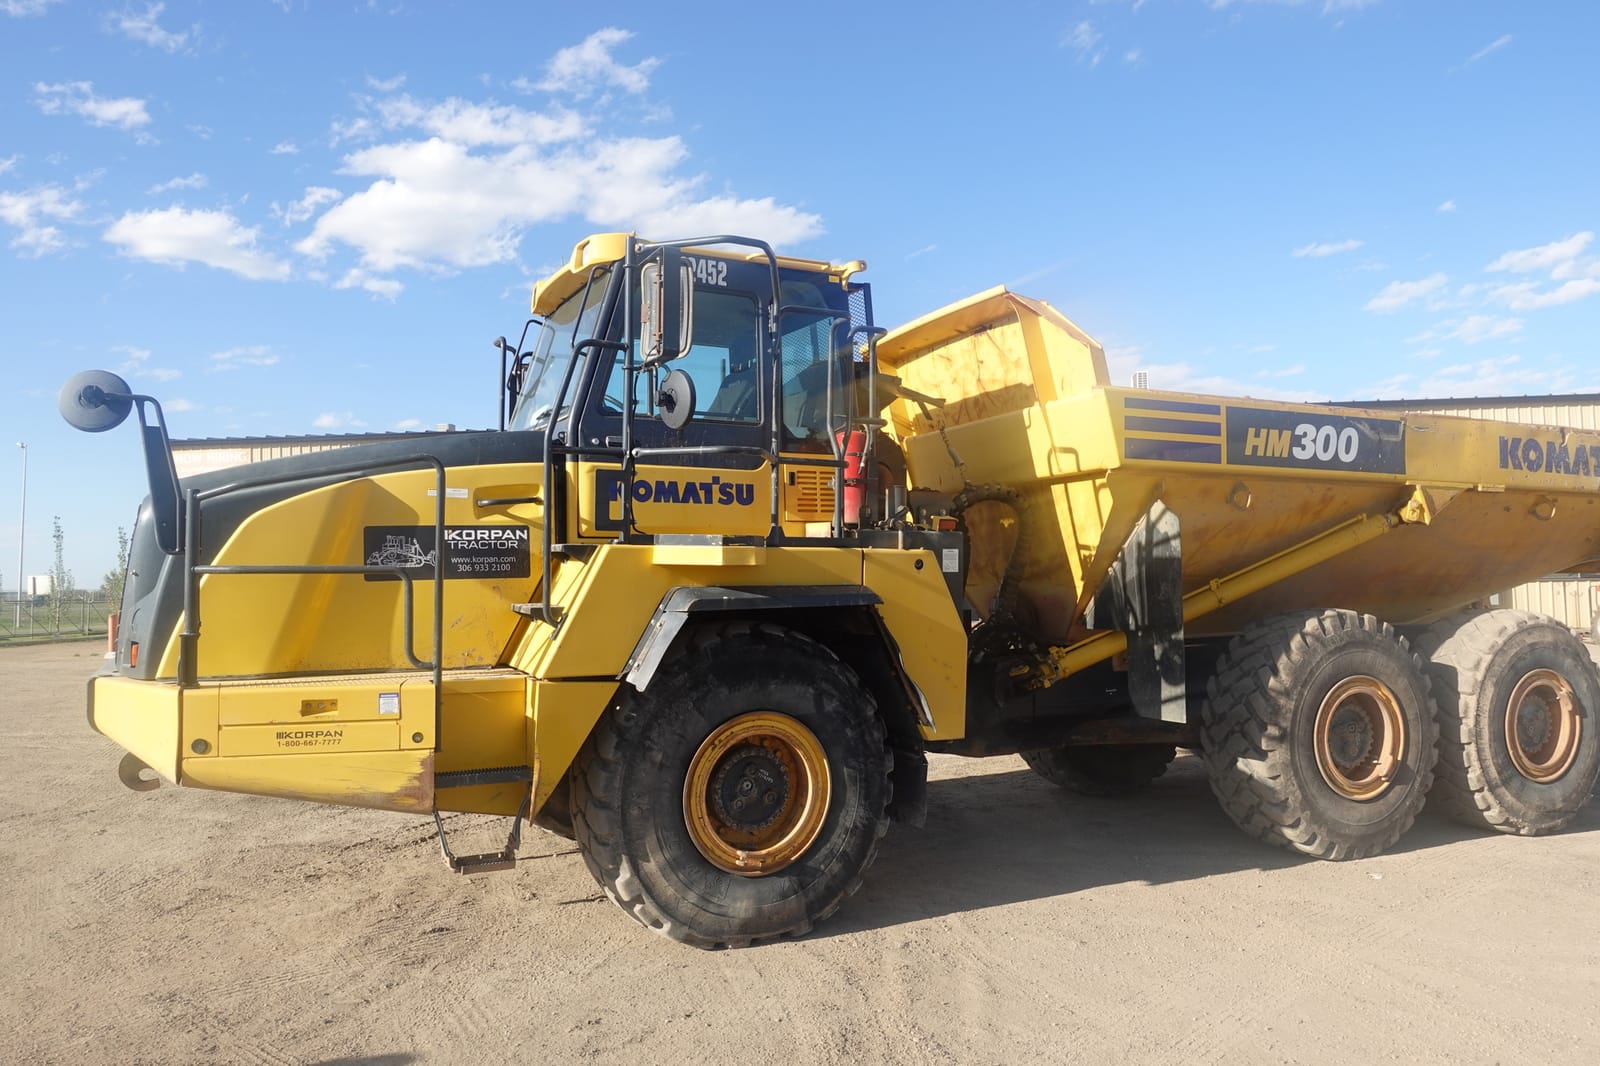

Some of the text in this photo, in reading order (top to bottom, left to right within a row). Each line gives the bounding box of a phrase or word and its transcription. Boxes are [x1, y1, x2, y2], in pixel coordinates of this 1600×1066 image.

[1244, 423, 1359, 463] HM300
[448, 529, 528, 540] KORPAN
[447, 540, 519, 550] TRACTOR
[450, 555, 517, 565] www.korpan.com
[457, 564, 473, 572] 306
[491, 563, 511, 571] 2100
[284, 730, 343, 739] KORPAN
[278, 738, 342, 747] 1-800-667-7777
